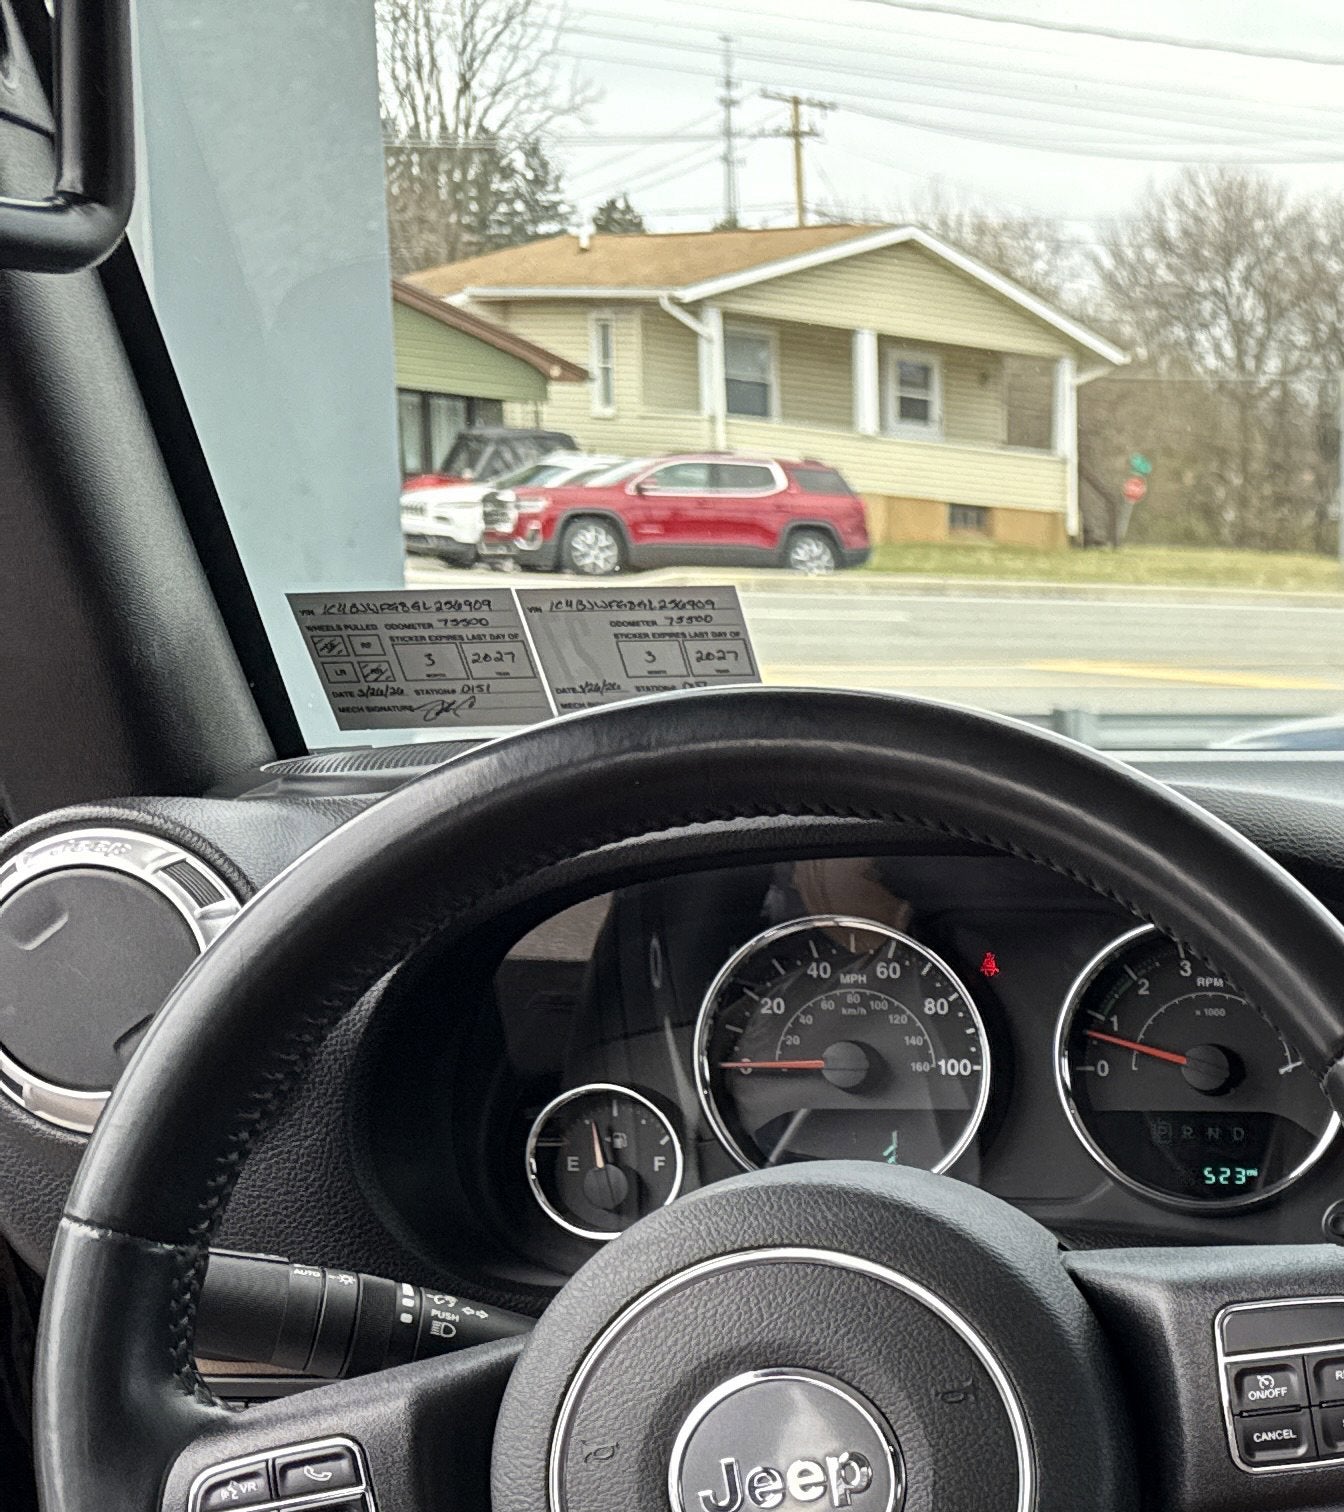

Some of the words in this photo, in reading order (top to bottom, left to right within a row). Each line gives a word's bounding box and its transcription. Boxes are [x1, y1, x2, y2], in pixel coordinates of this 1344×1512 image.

[466, 633, 488, 641] LAST
[471, 651, 516, 664] 2027
[644, 650, 656, 663] 3
[696, 650, 739, 662] 2027
[332, 691, 355, 699] DATE
[807, 962, 831, 978] 40
[876, 962, 901, 978] 60
[1180, 960, 1192, 977] 3
[840, 973, 867, 984] MPH
[1196, 977, 1224, 987] RPM
[1137, 978, 1150, 995] 2
[760, 998, 785, 1014] 20
[821, 1000, 835, 1010] 60
[841, 1006, 867, 1016] km/h
[869, 1000, 889, 1010] 100
[924, 998, 949, 1015] 80
[1203, 1007, 1226, 1017] 1000
[799, 1014, 813, 1025] 40
[888, 1014, 908, 1025] 120
[1111, 1015, 1119, 1031] 1
[786, 1035, 800, 1045] 20
[904, 1035, 923, 1046] 140
[910, 1062, 930, 1072] 160
[937, 1059, 972, 1076] 100
[1097, 1060, 1109, 1077] 0
[567, 1156, 580, 1172] E
[653, 1156, 666, 1172] F
[293, 1268, 321, 1278] AUTO
[430, 1309, 460, 1323] PUSH
[1248, 1387, 1288, 1401] ON/OFF
[1253, 1429, 1297, 1443] CANCEL
